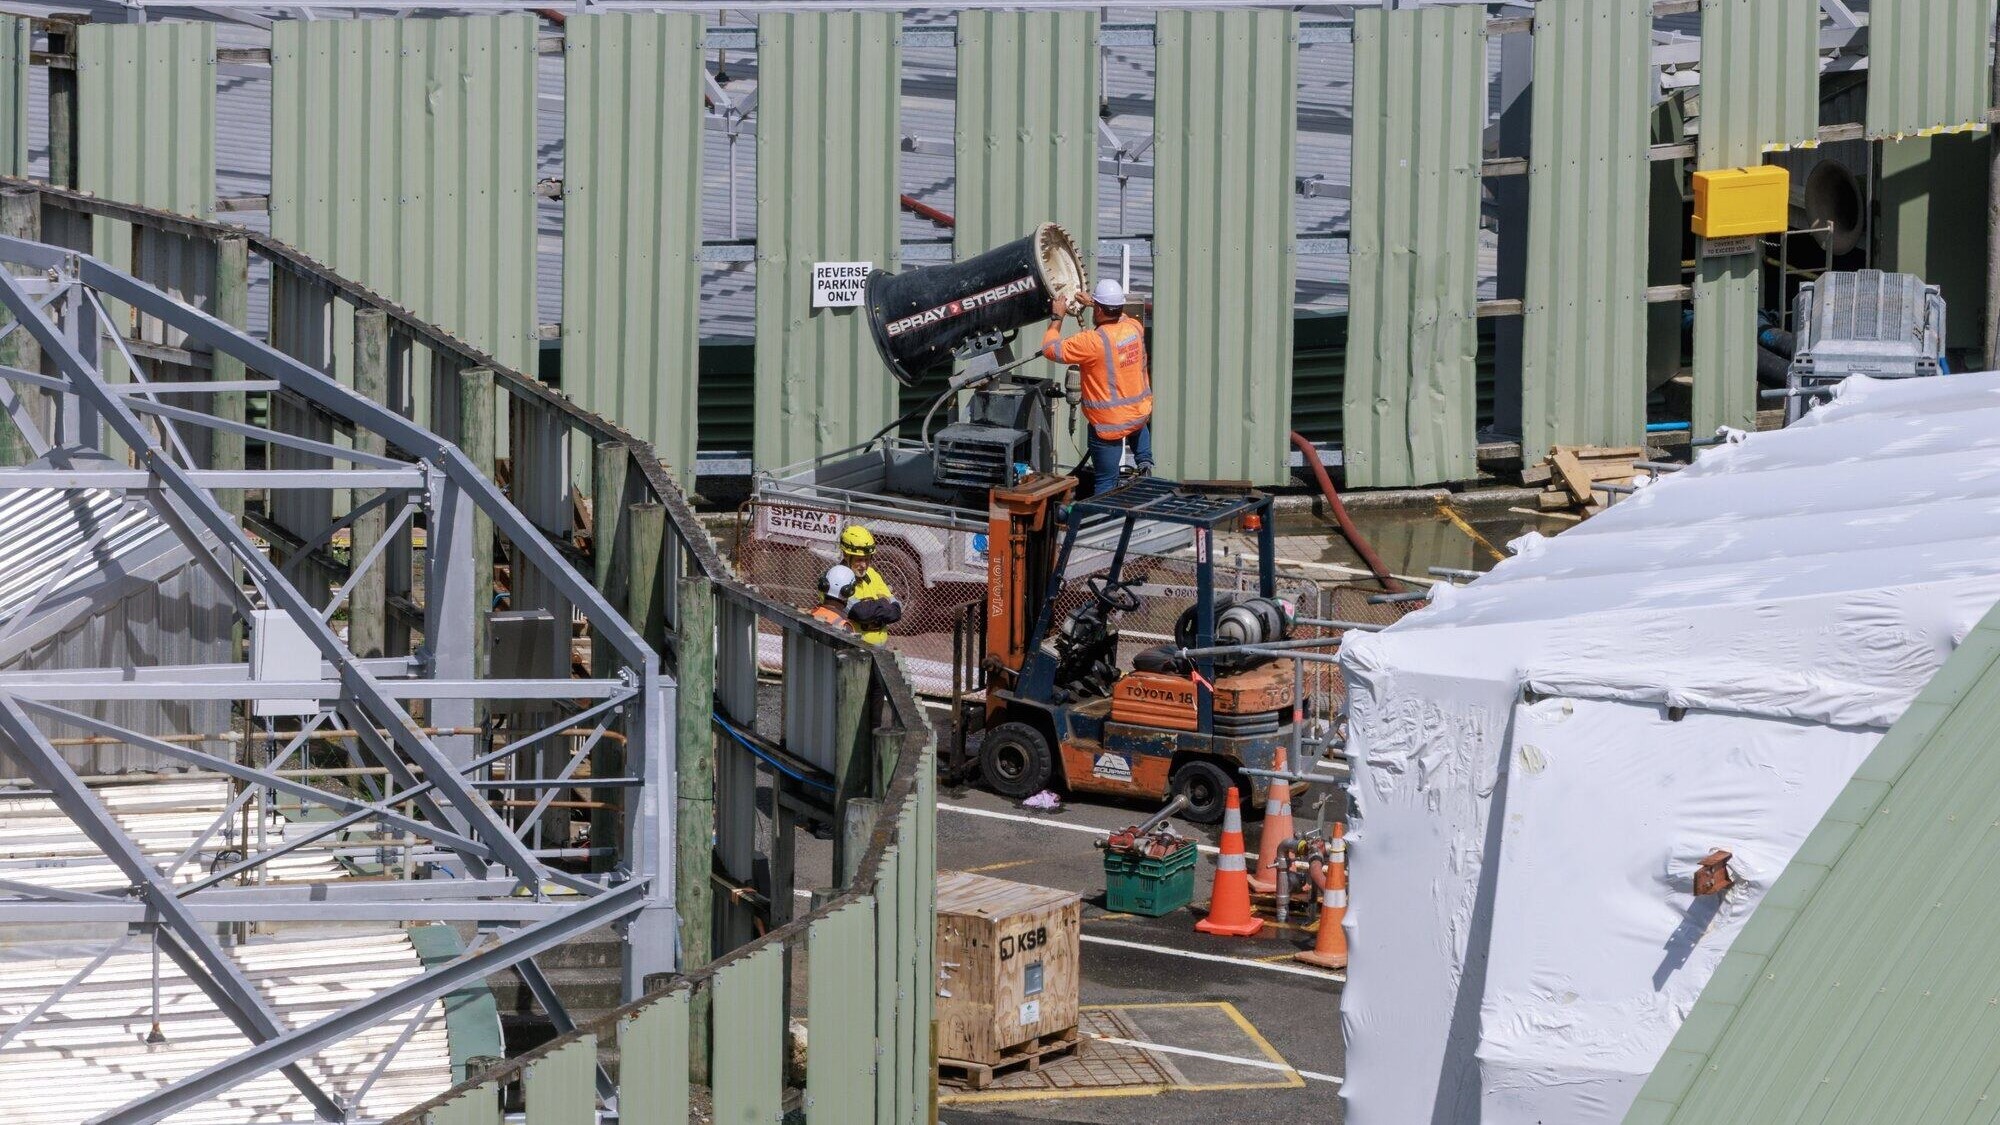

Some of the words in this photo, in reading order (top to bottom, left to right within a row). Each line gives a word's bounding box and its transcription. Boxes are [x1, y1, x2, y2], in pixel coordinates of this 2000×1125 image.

[817, 266, 869, 278] REVERSE
[818, 279, 867, 290] PARKING
[827, 291, 858, 302] ONLY
[887, 306, 947, 337] SPRAY
[962, 275, 1037, 310] STREAM
[771, 506, 824, 522] SPRAY
[771, 516, 837, 535] STREAM
[992, 555, 1004, 617] TOYOTA
[1126, 686, 1175, 702] TOYOTA
[1178, 692, 1193, 704] 18
[1018, 927, 1047, 953] KSB
